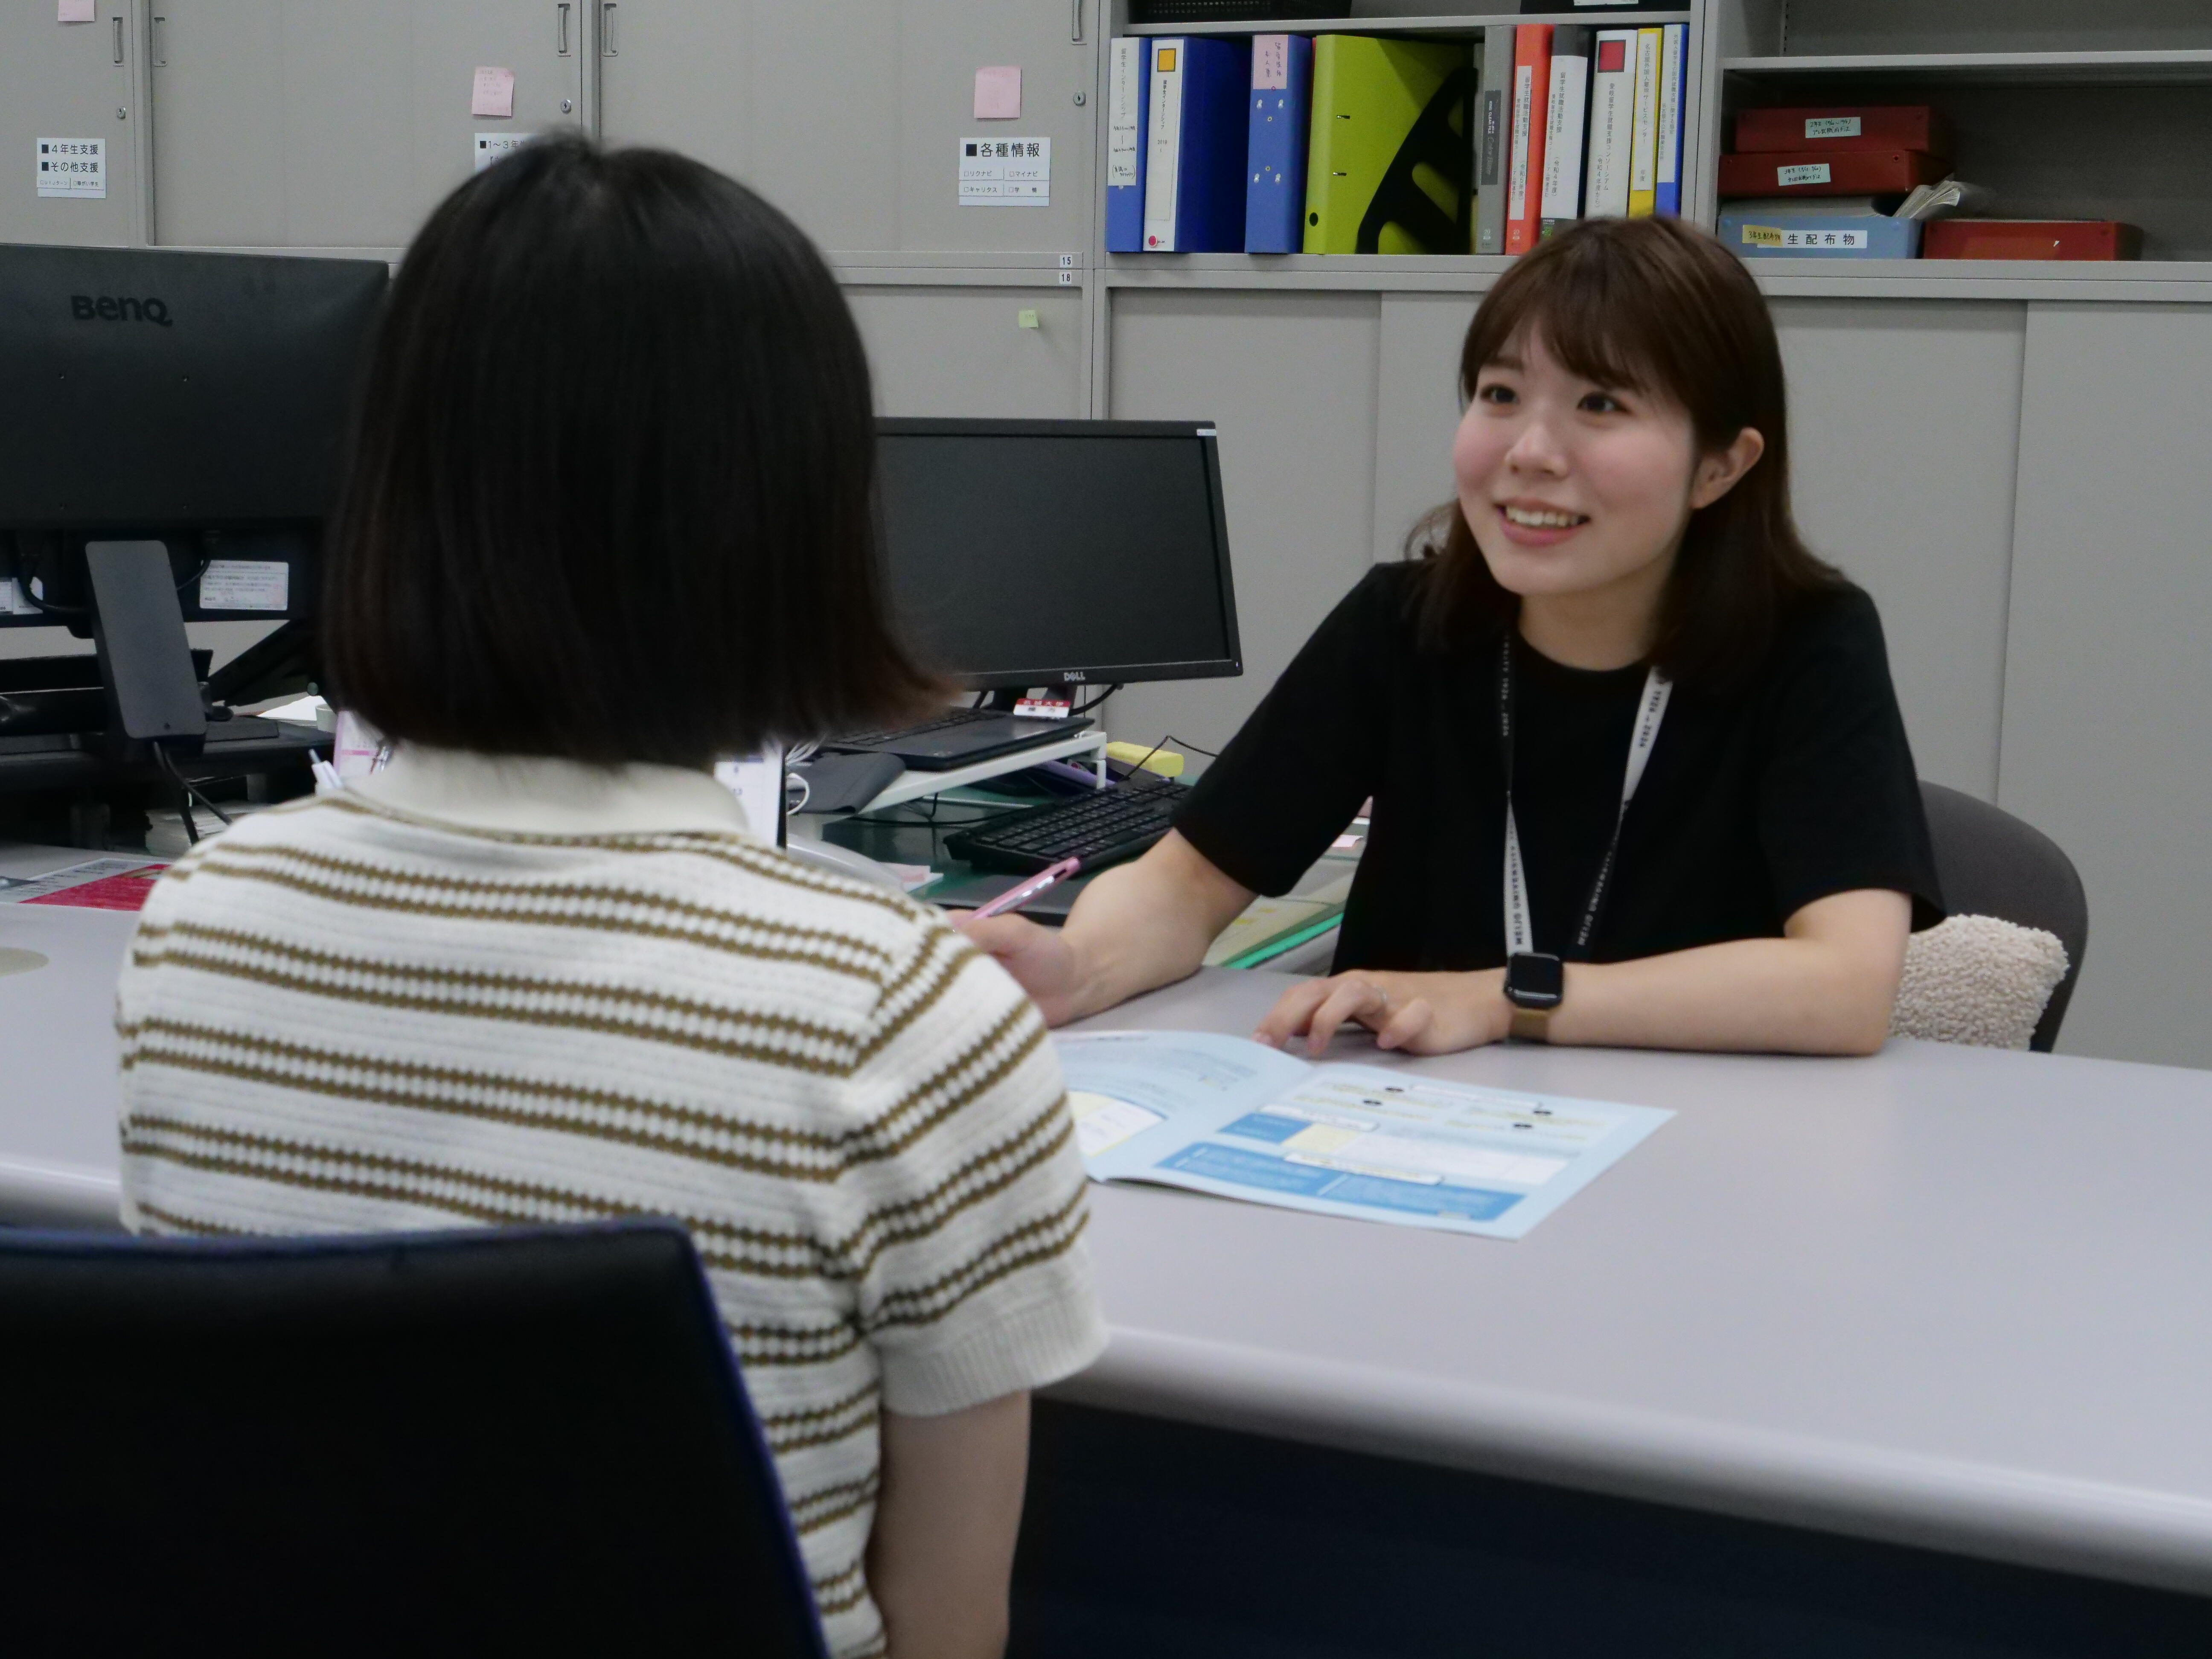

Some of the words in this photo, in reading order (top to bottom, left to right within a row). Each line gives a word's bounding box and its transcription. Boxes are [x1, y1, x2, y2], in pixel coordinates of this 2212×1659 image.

[1522, 76, 1531, 137] 留学生就職活動支援
[1556, 72, 1566, 133] 留学生就職活動支援
[52, 144, 99, 155] 4年生支援
[981, 143, 1040, 157] 各種情報
[51, 161, 99, 173] その他支援
[1062, 256, 1071, 265] 15
[1062, 274, 1071, 282] 18
[71, 295, 173, 327] BenQ
[1064, 671, 1086, 682] DELL
